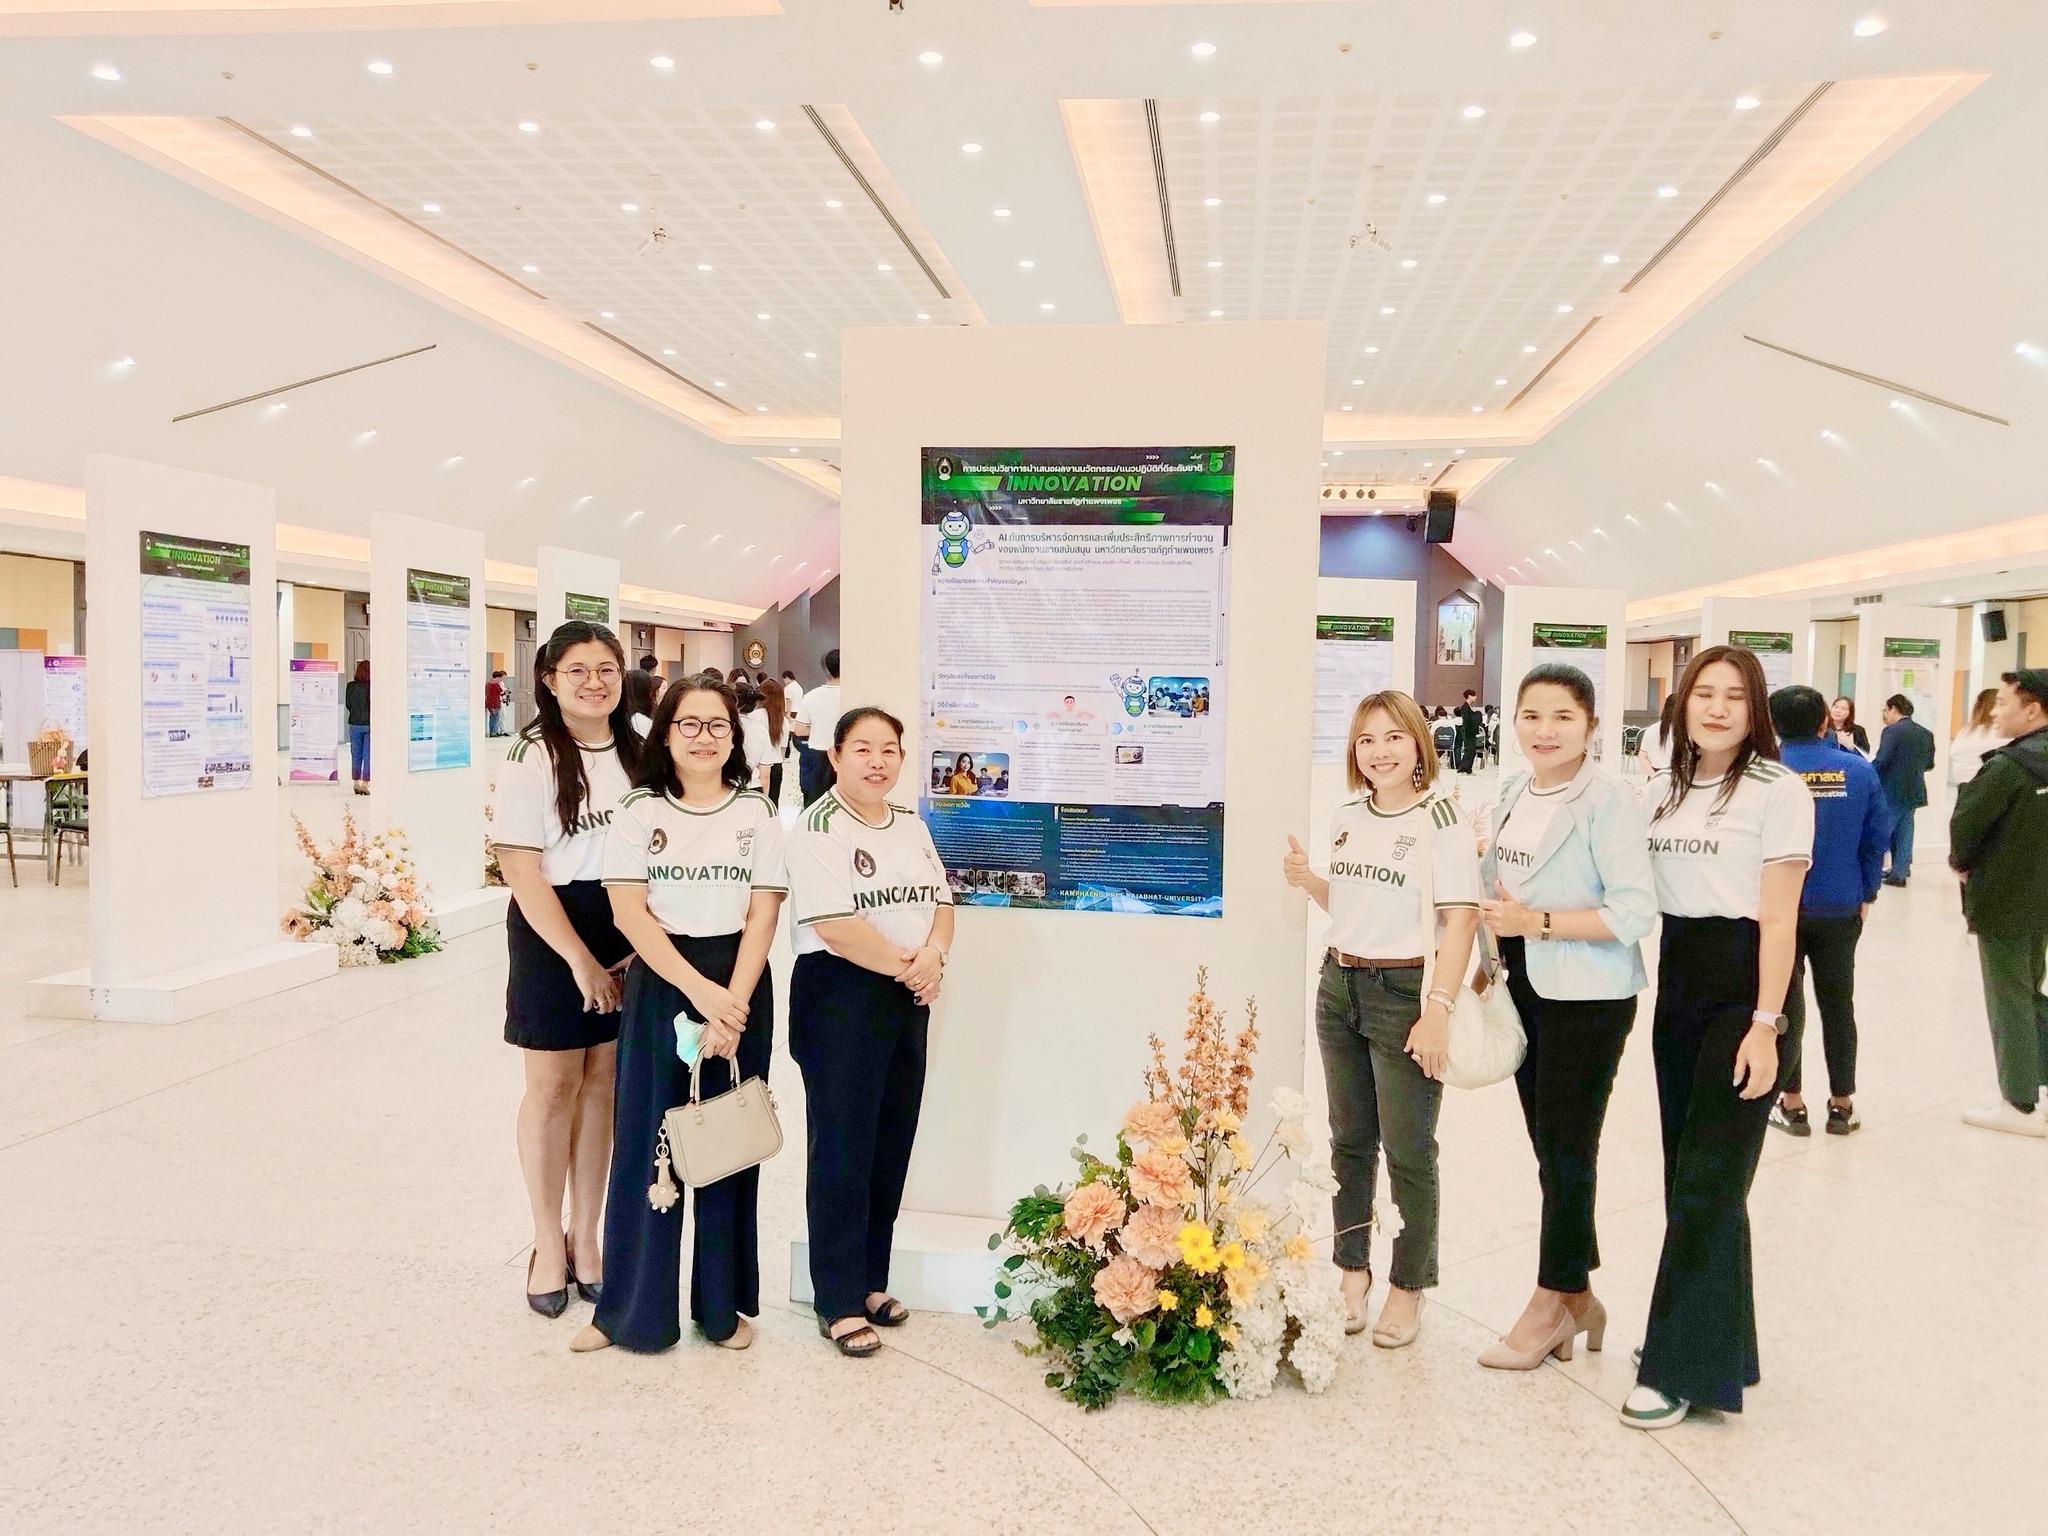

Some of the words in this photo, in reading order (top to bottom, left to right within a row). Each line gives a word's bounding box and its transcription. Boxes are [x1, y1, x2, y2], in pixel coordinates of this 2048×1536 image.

[1209, 452, 1224, 473] 5
[1006, 475, 1142, 492] INNOVATION
[1017, 496, 1122, 507] มหาวิทยาลัยราชภัฏกำแพงเพชร
[998, 533, 1007, 542] AI
[172, 549, 220, 565] INNOVATION
[739, 840, 751, 857] 5
[1391, 844, 1409, 861] 5
